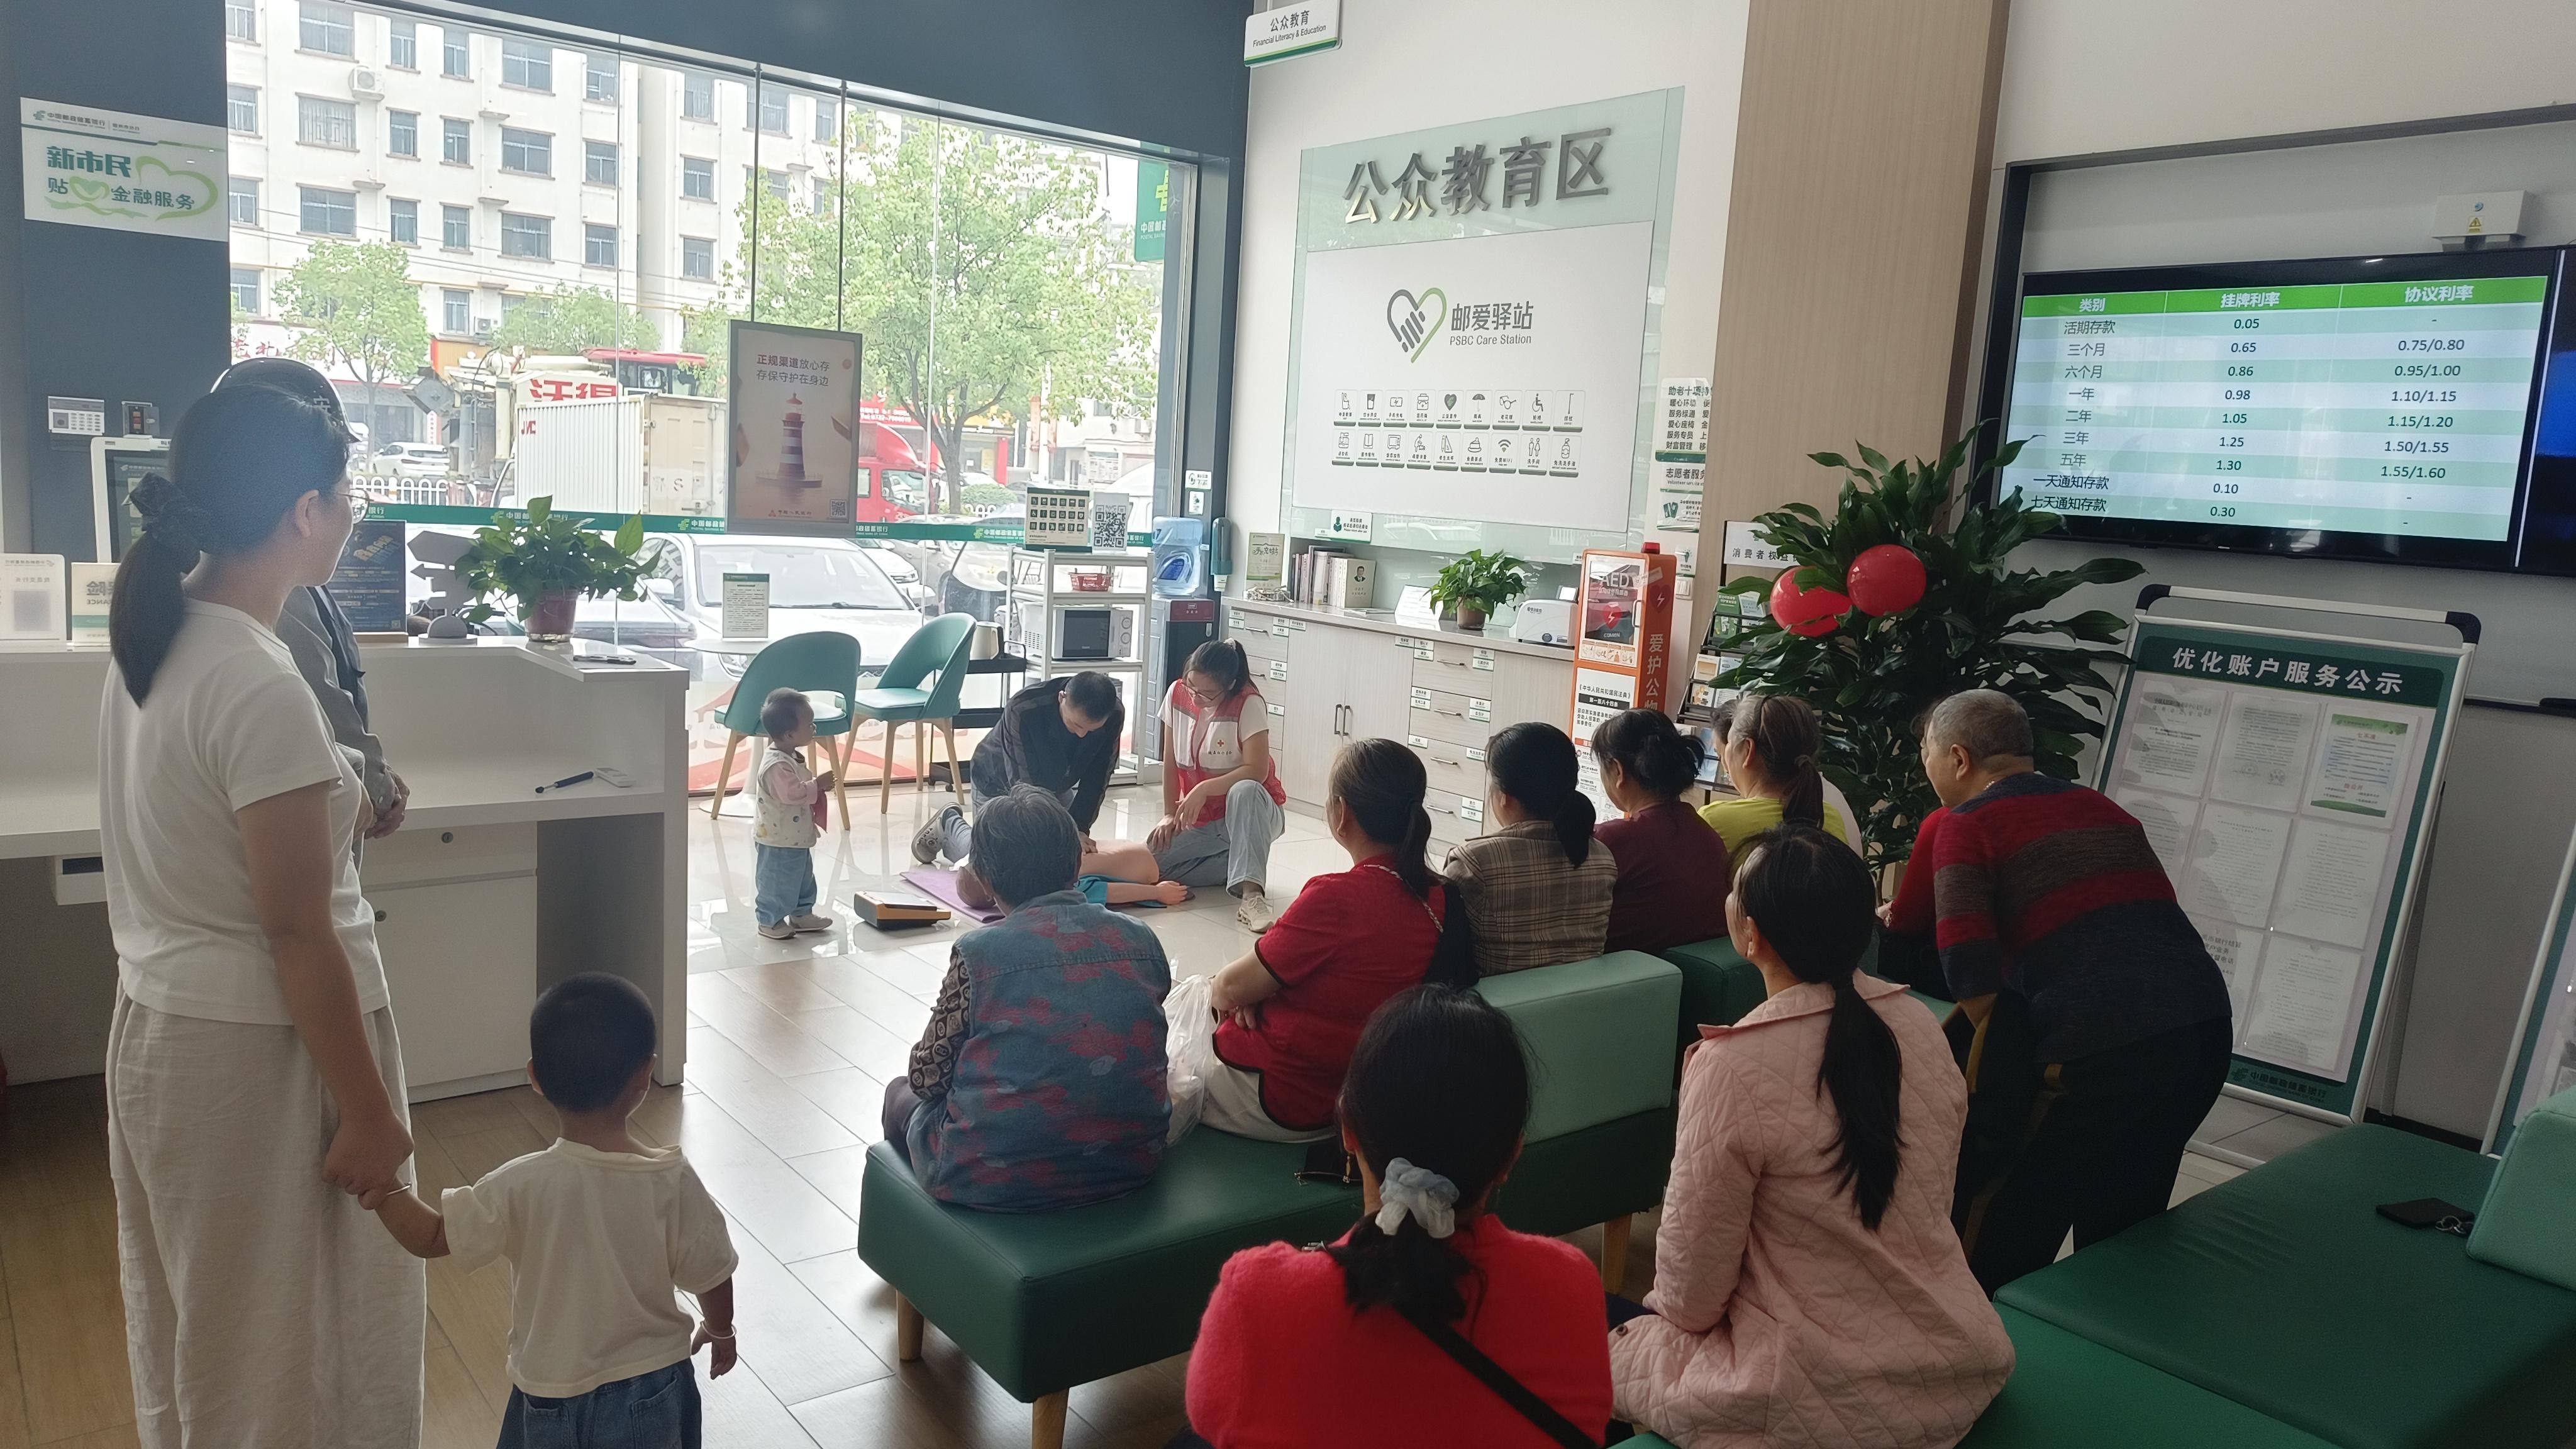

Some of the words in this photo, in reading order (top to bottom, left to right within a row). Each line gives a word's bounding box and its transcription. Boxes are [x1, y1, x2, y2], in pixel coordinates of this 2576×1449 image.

[1270, 9, 1309, 32] 公众教育
[1253, 37, 1274, 47] Financial
[1275, 32, 1294, 42] Literacy
[1301, 25, 1326, 36] Education
[47, 145, 131, 178] 新市民
[1342, 128, 1611, 225] 公众教育区
[48, 177, 69, 194] 贴
[111, 185, 194, 210] 金融服务
[2079, 297, 2106, 313] 类别
[2220, 292, 2281, 309] 挂牌利率
[2404, 285, 2475, 303] 协议利率
[1451, 301, 1534, 331] 邮爱驿站
[2063, 320, 2115, 335] 活期存款
[2234, 318, 2260, 330] 0.05
[1450, 335, 1474, 346] PSBC
[1476, 335, 1497, 345] Care
[1501, 333, 1531, 345] Station
[2067, 343, 2106, 357] 三个月
[2231, 342, 2257, 353] 0.65
[2398, 338, 2465, 352] 0.75/0.80
[757, 354, 830, 372] 正规渠道放心存
[2065, 365, 2102, 379] 六个月
[2228, 366, 2253, 377] 0.86
[2394, 364, 2461, 378] 0.95/1.00
[756, 370, 829, 387] 存保守护在身边
[2068, 387, 2094, 401] 一年
[2225, 389, 2250, 401] 0.98
[2391, 390, 2457, 402] 1.10/1.15
[1668, 420, 1695, 429] 爱心座椅
[2065, 409, 2092, 423] 二年
[2222, 413, 2247, 424] 1.05
[2387, 415, 2453, 429] 1.15/1.20
[1667, 430, 1694, 439] 服务专员
[1700, 431, 1707, 440] 上
[2062, 431, 2089, 445] 三年
[2219, 437, 2244, 447] 1.25
[2384, 441, 2449, 454] 1.50/1.55
[1665, 441, 1693, 450] 财富管理
[2060, 453, 2087, 467] 五年
[2216, 460, 2241, 471] 1.30
[2380, 466, 2446, 479] 1.55/1.60
[2033, 474, 2109, 491] 一天通知存款
[2213, 483, 2239, 494] 0.10
[2031, 495, 2107, 511] 七天通知存款
[2210, 506, 2236, 518] 0.30
[855, 525, 889, 533] 政储蓄银行
[1601, 572, 1630, 588] AED
[2172, 647, 2403, 694] 优化账户服务公示
